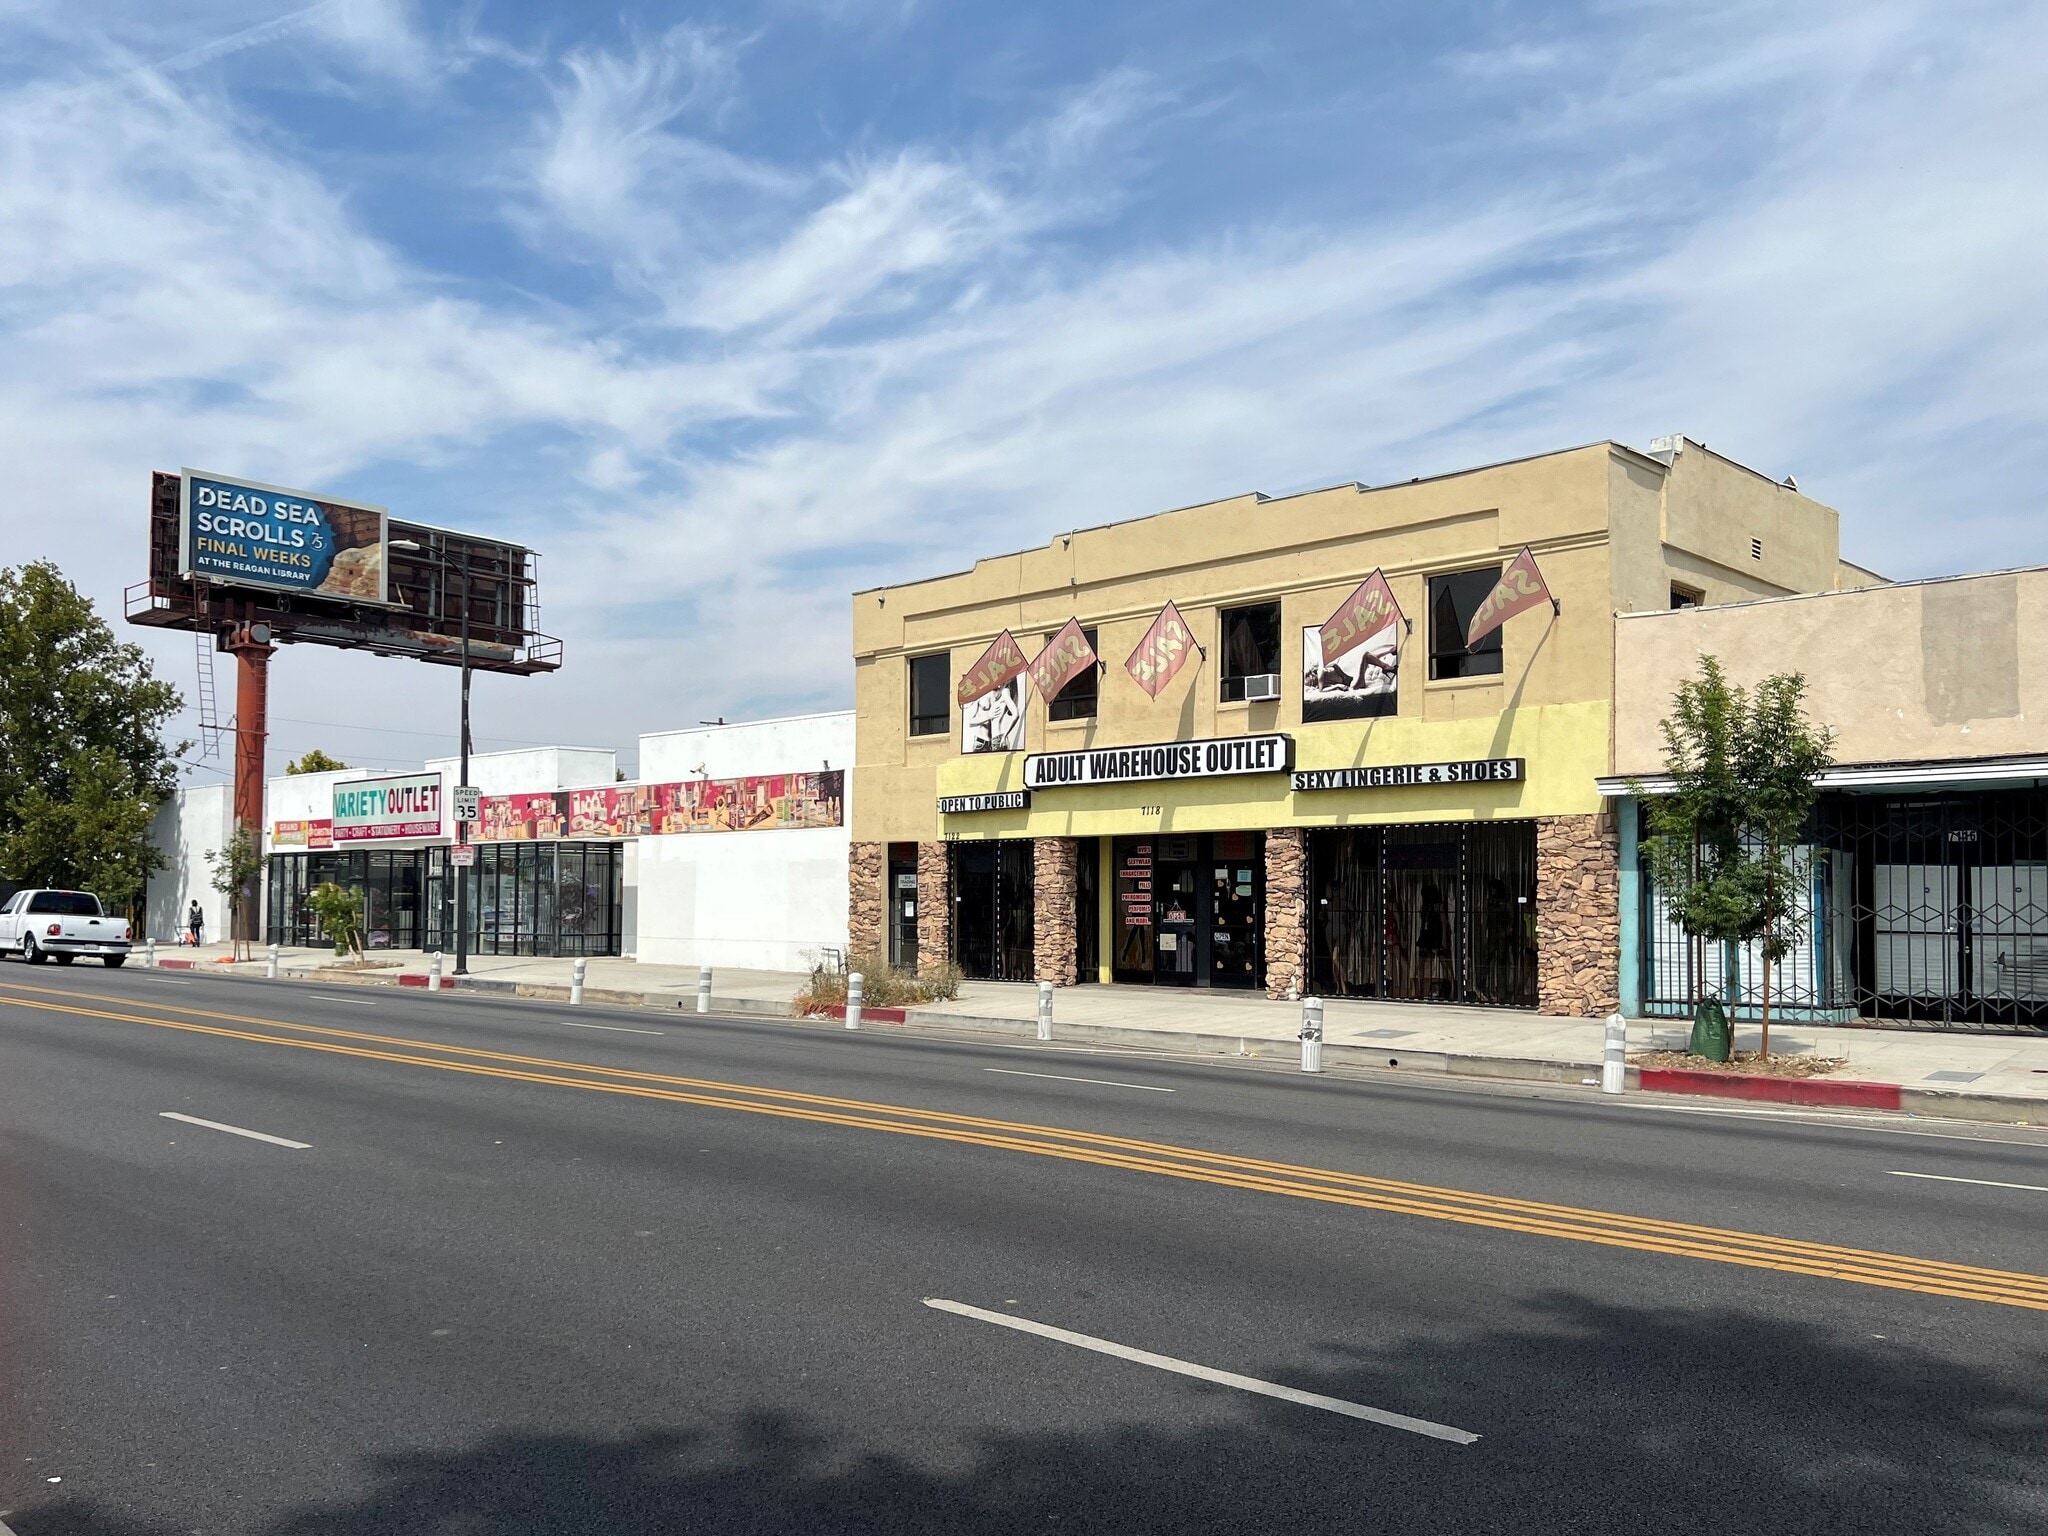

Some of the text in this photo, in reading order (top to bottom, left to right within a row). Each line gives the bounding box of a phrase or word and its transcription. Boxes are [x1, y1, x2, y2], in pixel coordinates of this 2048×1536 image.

[199, 487, 320, 526] DEAD SEA
[197, 513, 305, 548] SCROLLS
[311, 532, 324, 549] 75
[197, 537, 311, 567] FINAL WEEKS
[198, 557, 311, 581] AT THE REAGAN LIBRARY
[1035, 739, 1278, 784] ADULT WAREHOUSE OUTLET
[1295, 760, 1512, 790] SEXY LINGERIE & SHOES
[334, 785, 439, 818] VARIETY OUTLET
[457, 805, 476, 818] 35
[941, 793, 1021, 812] OPEN TO PUBLIC
[1141, 805, 1161, 816] 7118
[352, 827, 367, 838] CRAFT
[404, 822, 438, 835] HOUSEWARE
[944, 832, 960, 840] 7122
[1168, 912, 1185, 920] OPEN
